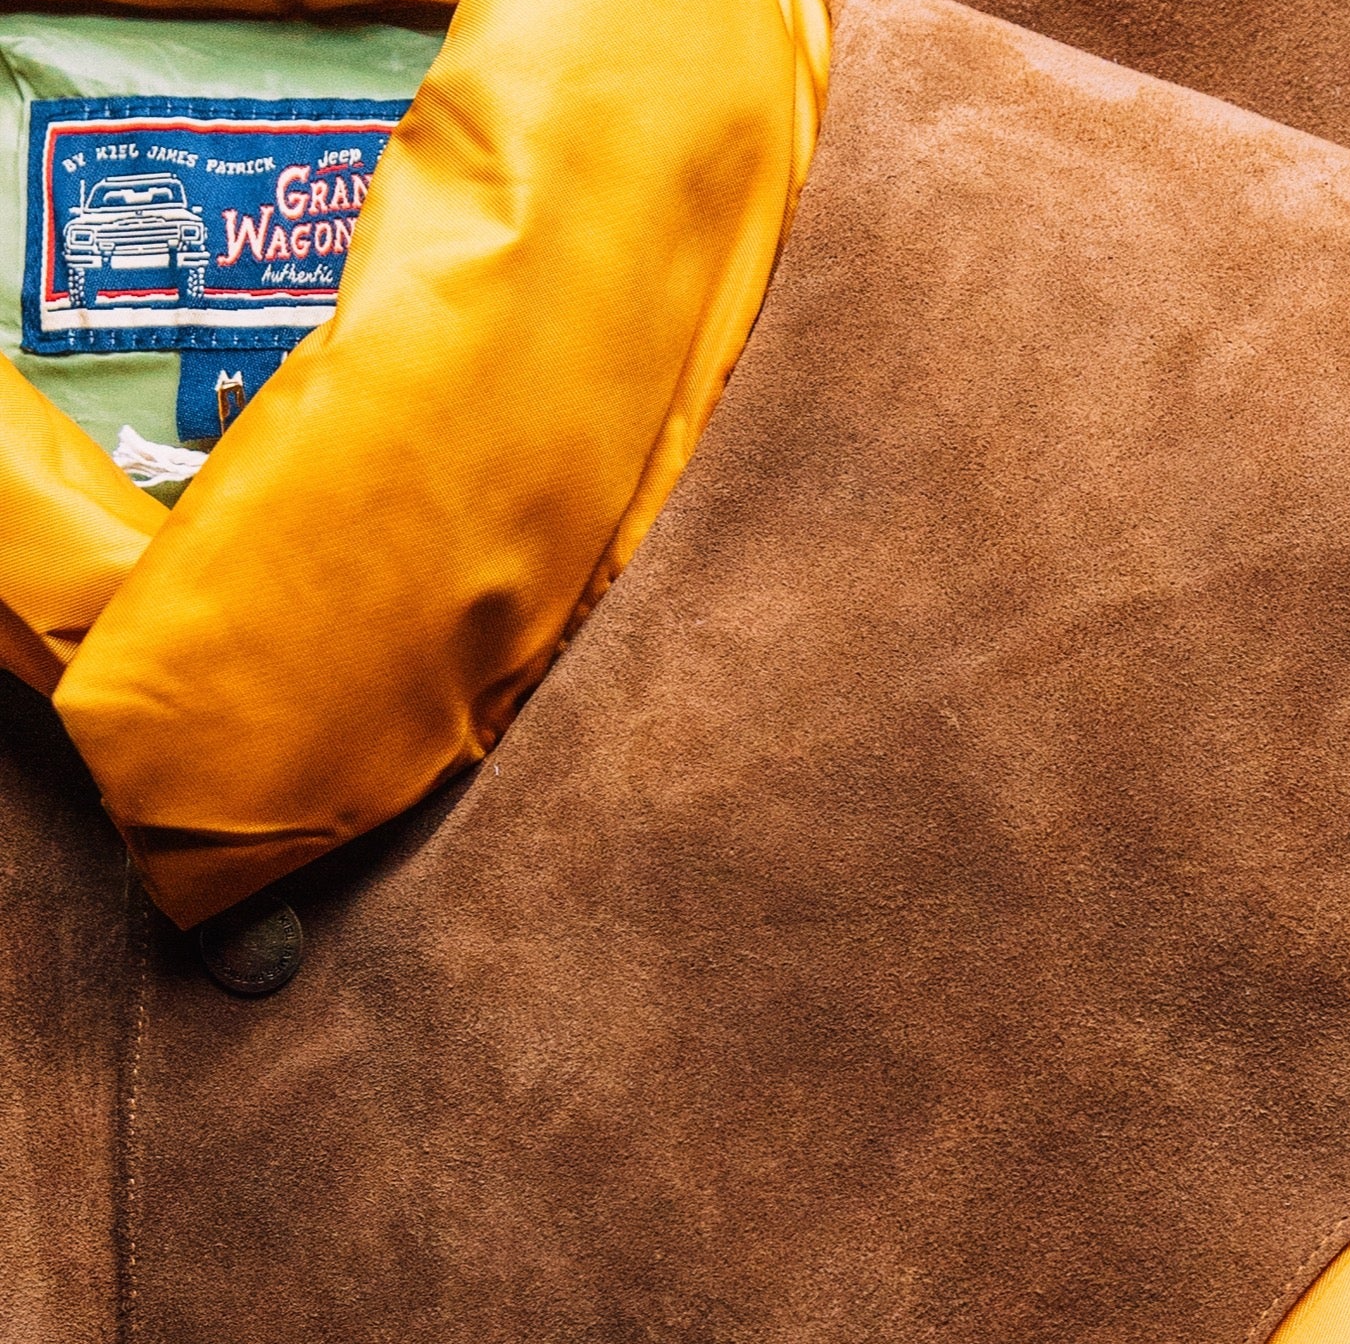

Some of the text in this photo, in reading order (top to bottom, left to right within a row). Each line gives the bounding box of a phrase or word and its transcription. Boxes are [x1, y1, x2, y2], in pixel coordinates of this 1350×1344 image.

[62, 152, 86, 173] BY
[147, 145, 199, 168] JAMES
[206, 156, 276, 175] PATRICK
[318, 148, 362, 168] Jeep
[276, 164, 374, 221] GRAN
[217, 204, 359, 267] WAGON
[262, 264, 334, 284] Authentic
